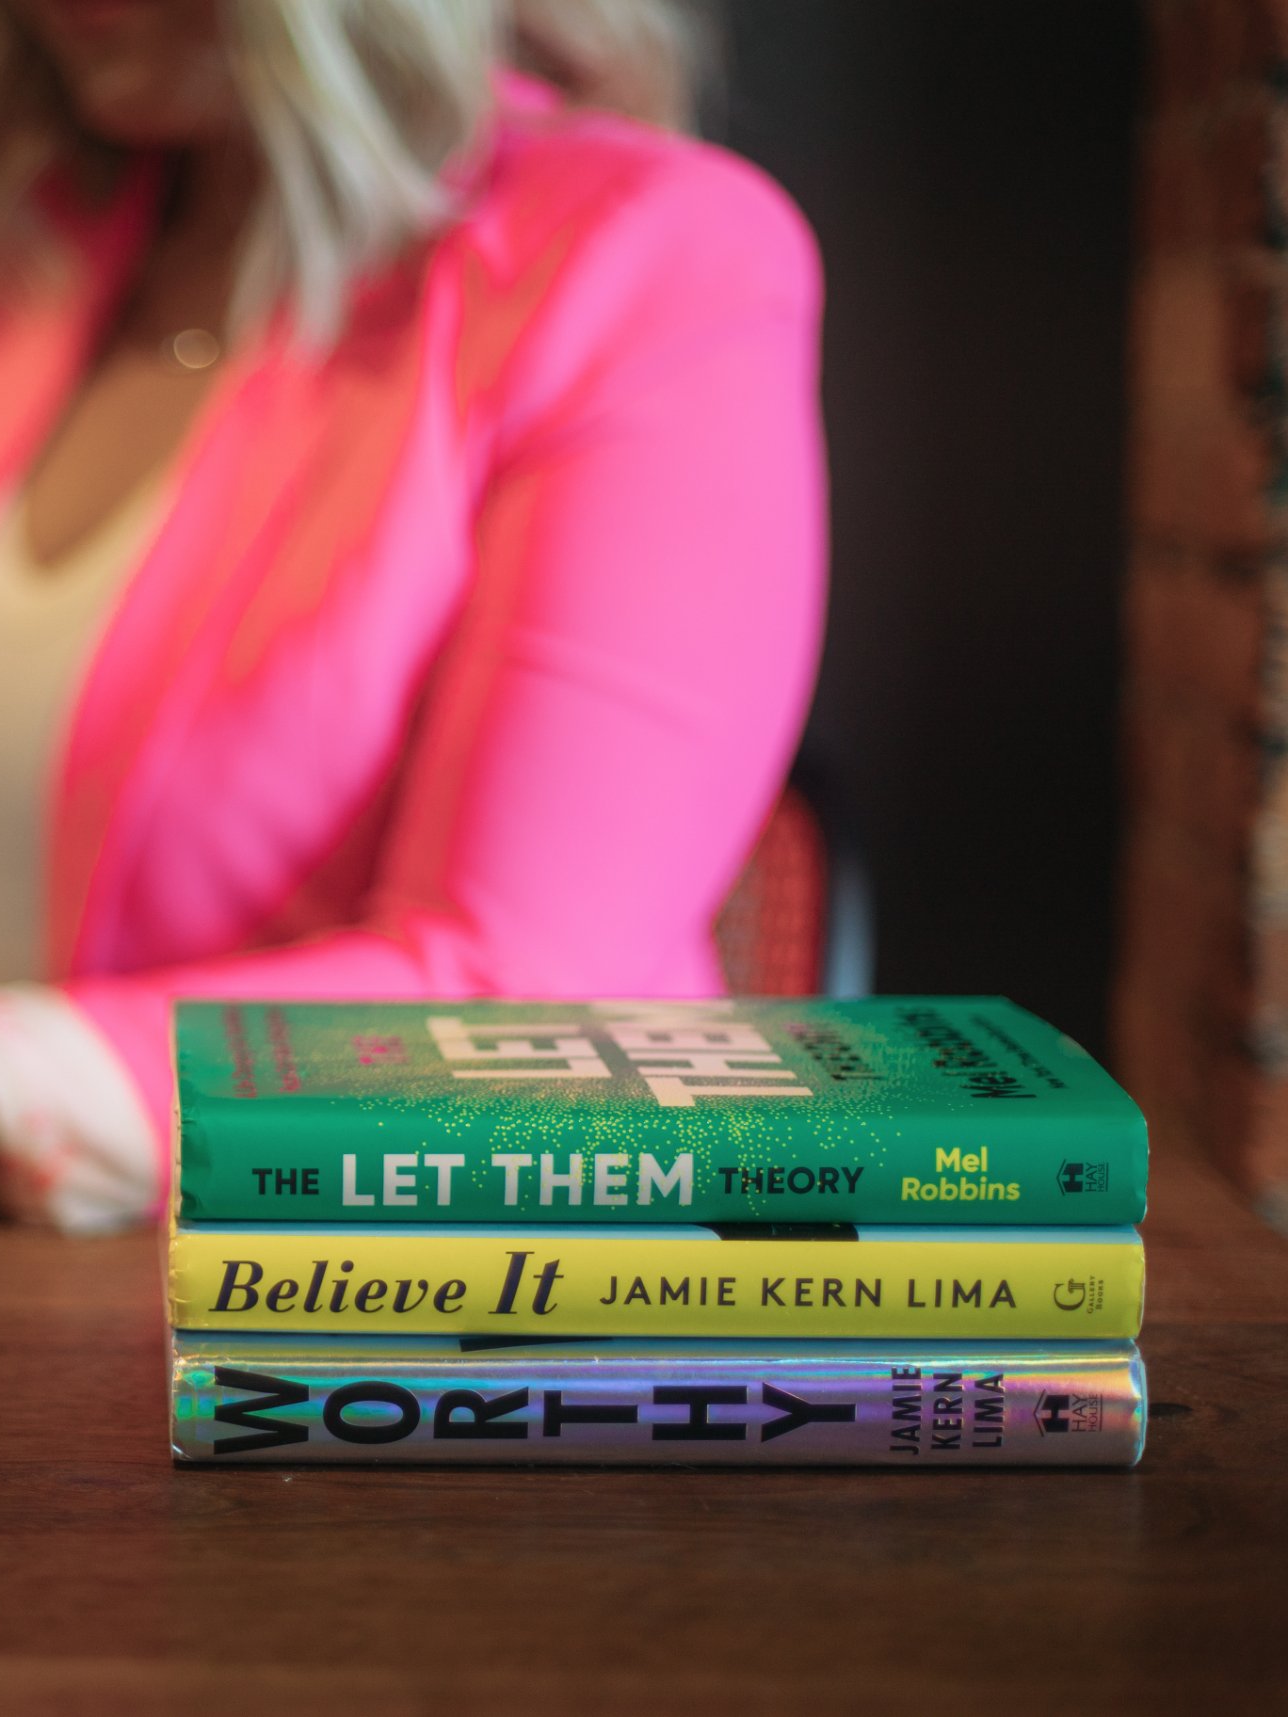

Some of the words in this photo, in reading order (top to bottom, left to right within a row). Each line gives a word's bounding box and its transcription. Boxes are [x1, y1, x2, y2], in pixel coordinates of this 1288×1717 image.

[427, 1017, 611, 1078] LET
[252, 1168, 319, 1195] THE
[343, 1154, 465, 1206] LET
[491, 1153, 694, 1206] THEM
[718, 1167, 864, 1195] THEORY
[936, 1146, 988, 1172] Mel
[1085, 1162, 1097, 1192] HAY
[901, 1176, 1020, 1202] Robbins
[208, 1260, 467, 1314] Believe
[488, 1251, 564, 1315] It
[599, 1276, 737, 1306] JAMIE
[761, 1277, 882, 1307] KERN
[907, 1279, 1017, 1309] LIMA
[214, 1366, 856, 1455] WORTHY
[890, 1367, 922, 1454] JAMIE
[931, 1373, 963, 1450] KERN
[973, 1373, 1004, 1447] LIMA
[1072, 1393, 1087, 1432] HAY
